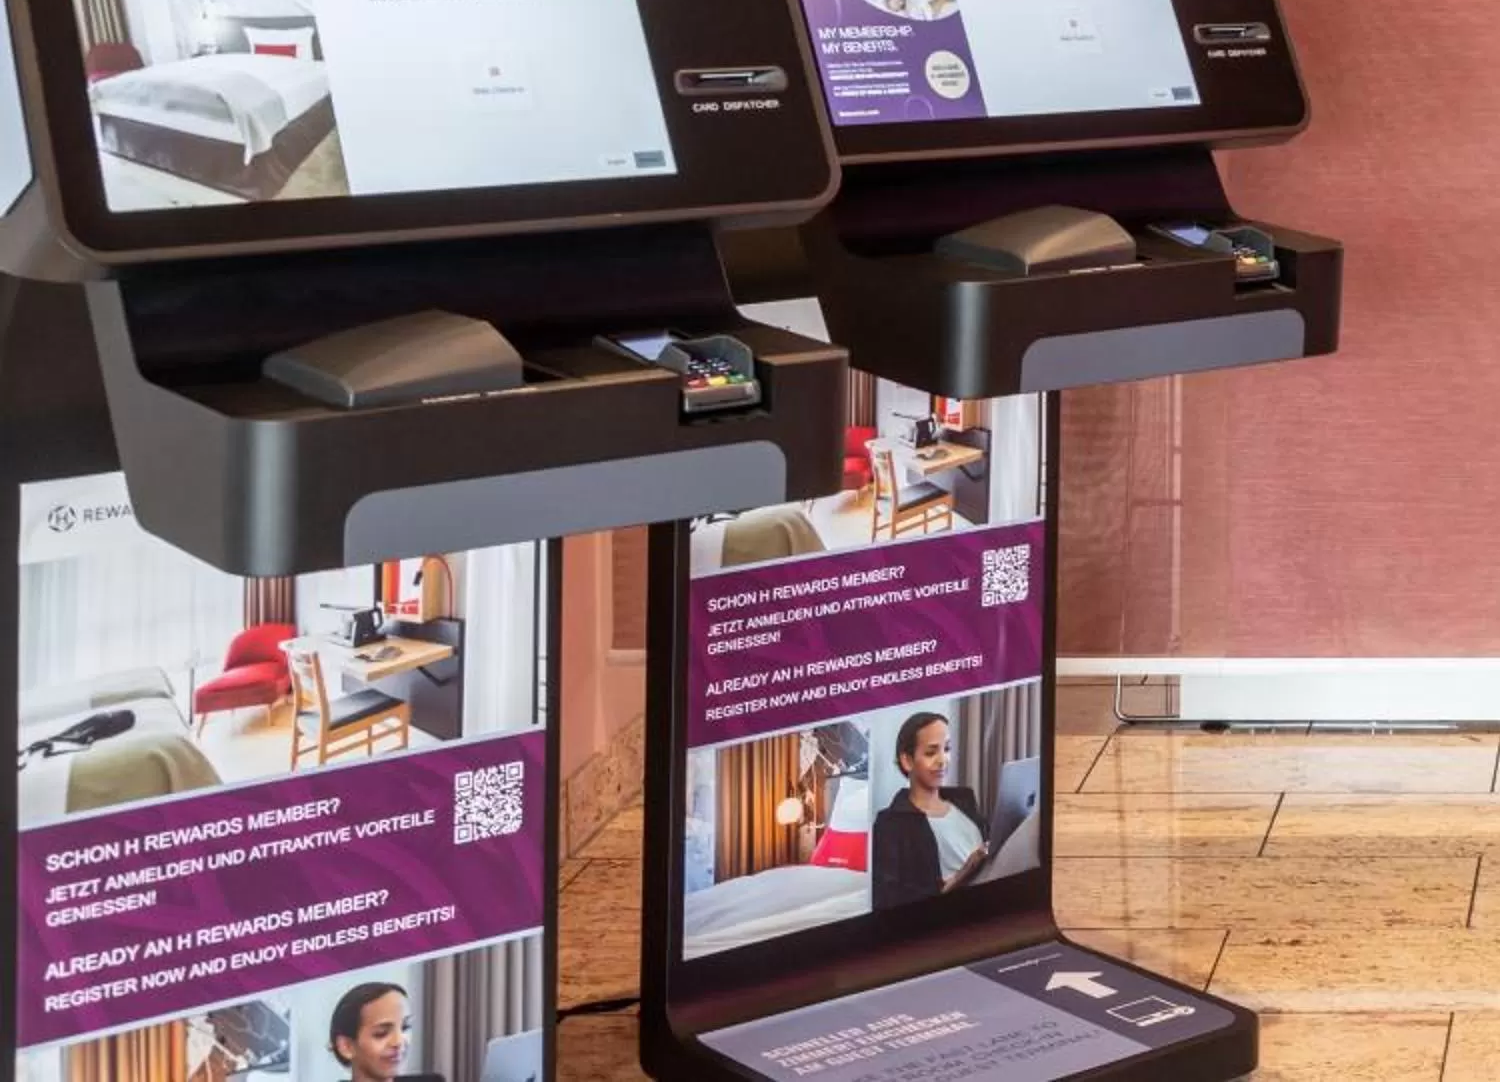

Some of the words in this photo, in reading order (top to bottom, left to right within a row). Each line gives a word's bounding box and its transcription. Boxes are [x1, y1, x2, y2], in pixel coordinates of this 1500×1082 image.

[818, 27, 836, 39] MY
[821, 42, 840, 54] MY
[692, 102, 719, 113] CARD
[723, 99, 779, 111] DISPATCHER
[707, 591, 757, 612] SCHON
[760, 589, 770, 602] H
[773, 577, 839, 599] REWARDS
[842, 566, 905, 587] MEMBER?
[707, 619, 744, 637] JETZT
[746, 607, 812, 630] ANMELDEN
[814, 602, 840, 617] UND
[842, 589, 912, 612] ATTRAKTIVE
[914, 578, 970, 598] VORTEILE
[705, 672, 768, 697] ALREADY
[771, 667, 790, 684] AN
[793, 666, 803, 678] H
[807, 652, 872, 677] REWARDS
[875, 639, 937, 663] MEMBER?
[707, 630, 781, 655] GENIESSEN!
[705, 698, 767, 721] REGISTER
[769, 691, 799, 707] NOW
[801, 685, 827, 701] AND
[829, 678, 868, 696] ENJOY
[870, 666, 923, 687] ENDLESS
[926, 655, 982, 677] BENEFITS!
[45, 878, 101, 904] JETZT
[104, 857, 203, 891] ANMELDEN
[207, 849, 245, 868] UND
[249, 827, 351, 862] ATTRAKTIVE
[355, 809, 435, 838] VORTEILE
[46, 842, 120, 871] SCHON
[125, 839, 139, 856] H
[144, 817, 242, 851] REWARDS
[247, 798, 340, 830] MEMBER?
[44, 944, 140, 981] ALREADY
[144, 937, 172, 958] AN
[177, 934, 192, 950] H
[196, 911, 292, 946] REWARDS
[297, 889, 389, 923] MEMBER?
[45, 890, 157, 927] GENIESSEN!
[44, 977, 137, 1012] REGISTER
[141, 967, 185, 990] NOW
[189, 958, 226, 979] AND
[231, 944, 288, 969] ENJOY
[292, 925, 369, 955] ENDLESS
[372, 906, 455, 936] BENEFITS!
